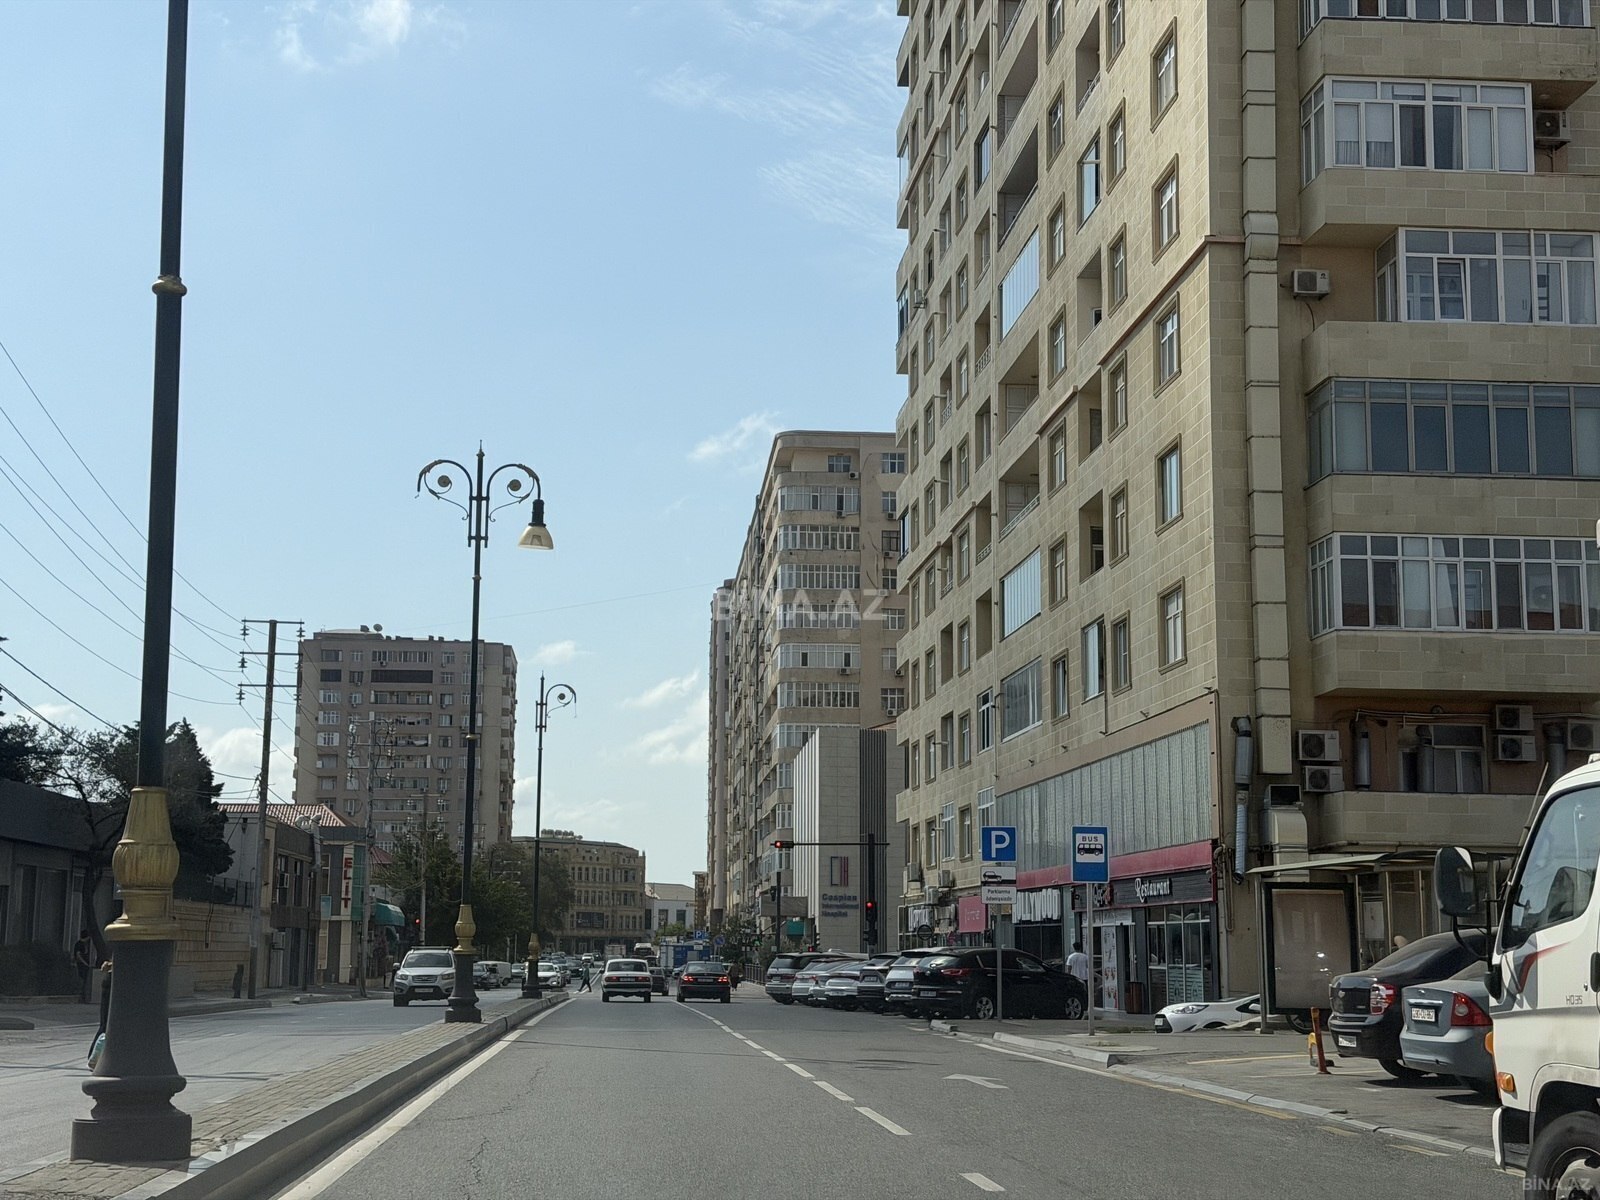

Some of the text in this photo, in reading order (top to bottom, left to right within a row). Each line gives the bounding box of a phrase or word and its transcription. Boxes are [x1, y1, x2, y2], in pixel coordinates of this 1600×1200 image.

[991, 831, 1009, 858] P
[822, 894, 857, 903] Caspian
[1134, 877, 1170, 903] Restaurant
